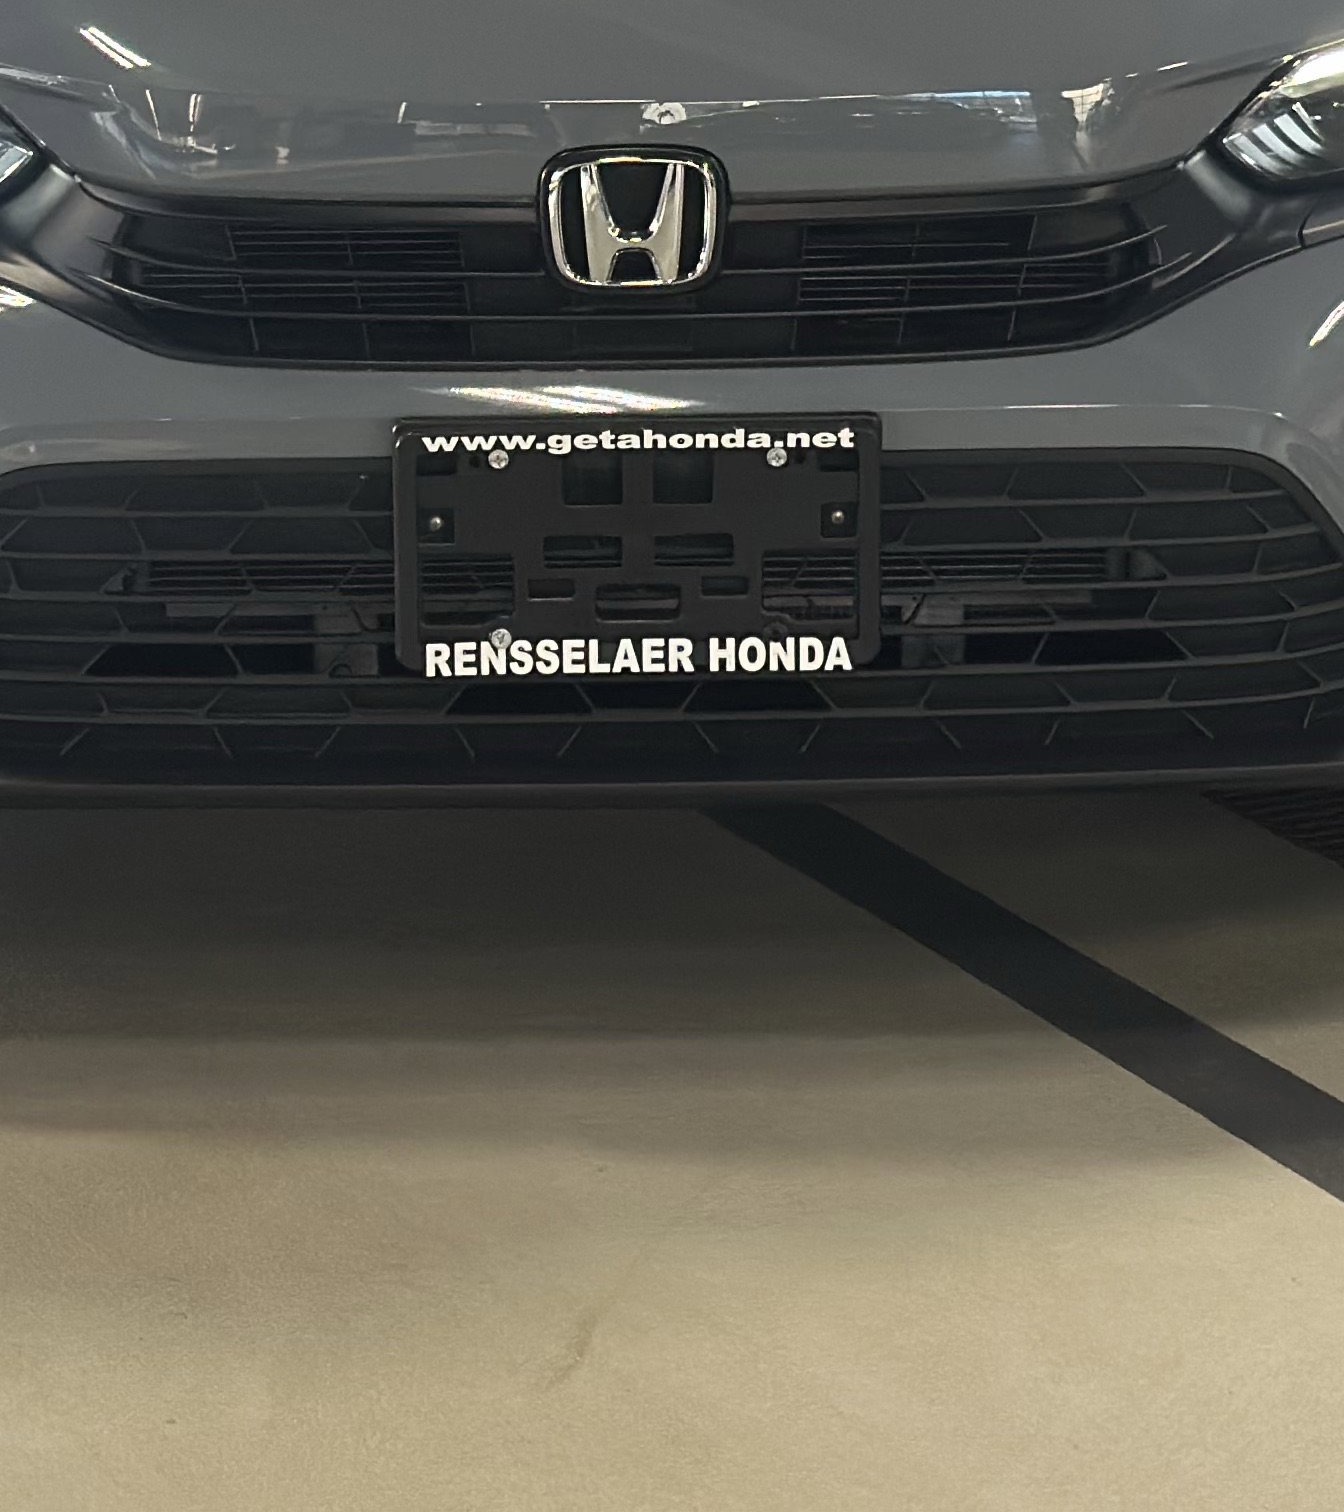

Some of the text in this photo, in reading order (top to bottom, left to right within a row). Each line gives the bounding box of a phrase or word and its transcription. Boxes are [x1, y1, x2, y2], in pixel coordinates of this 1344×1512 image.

[421, 427, 855, 455] www.getahonda.net
[425, 636, 853, 678] RENSSELAER HONDA
